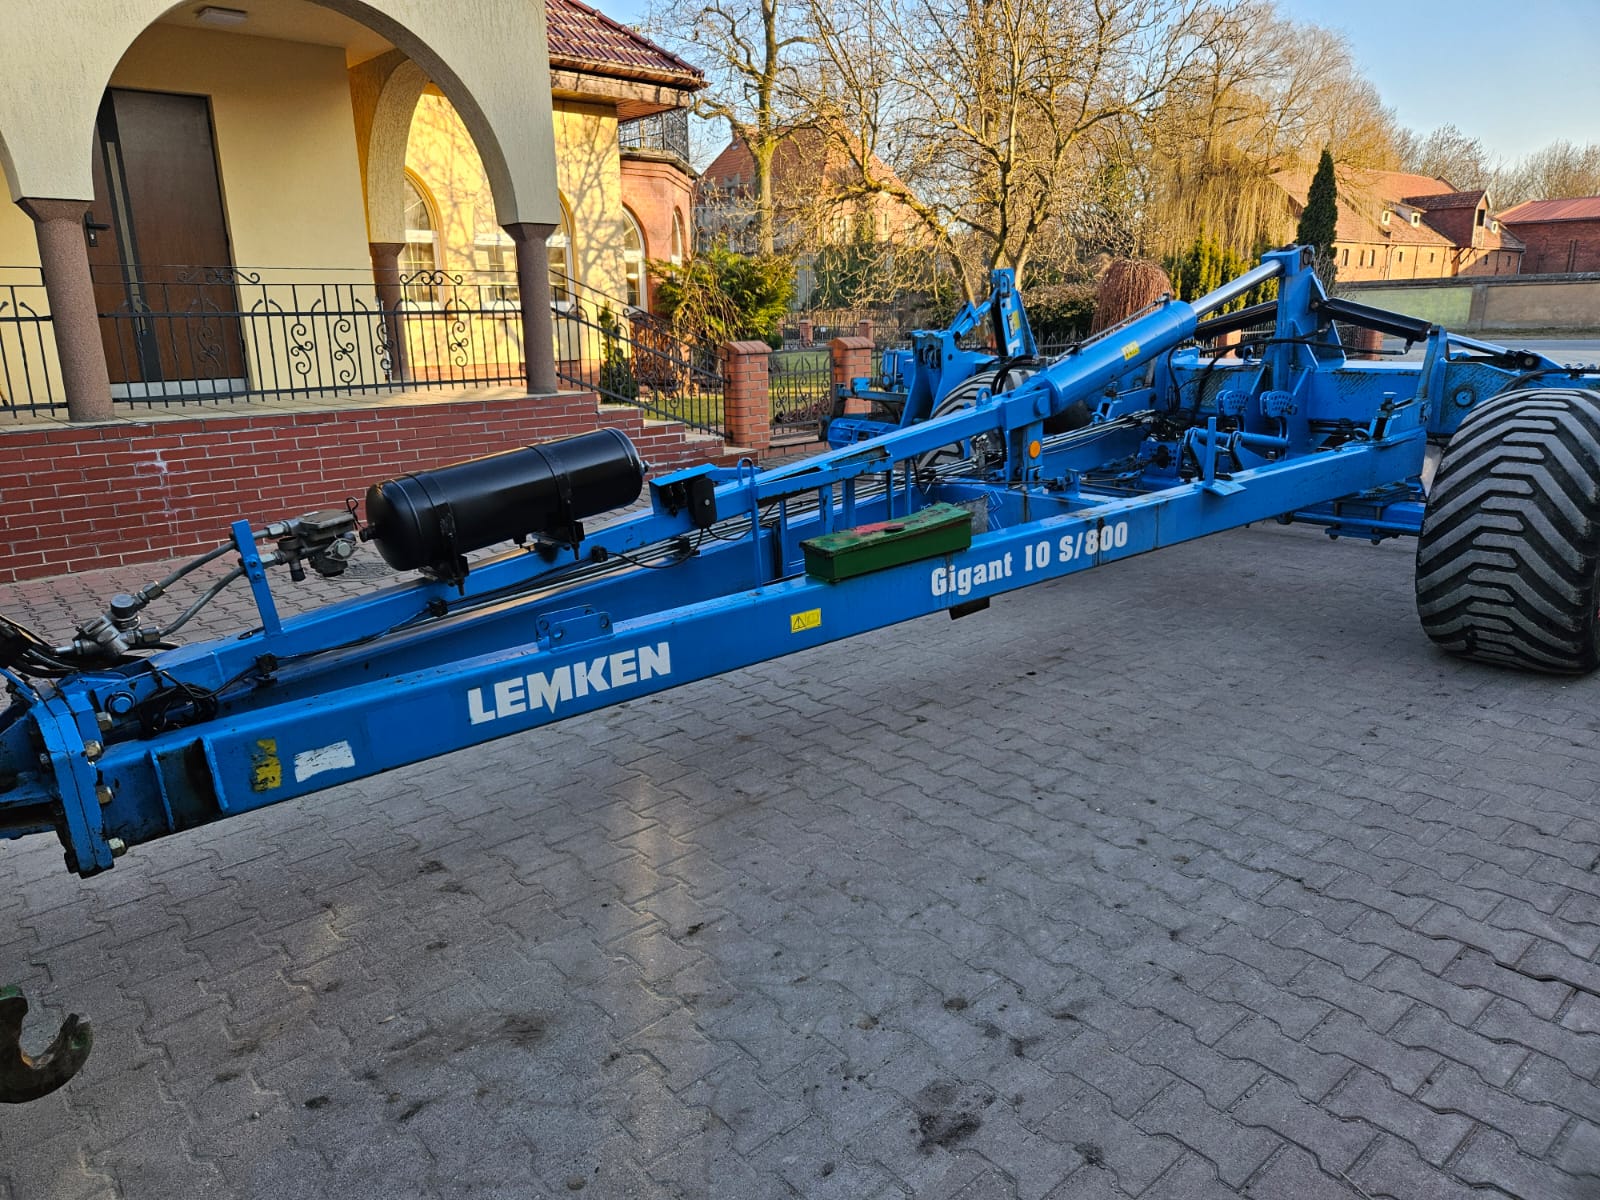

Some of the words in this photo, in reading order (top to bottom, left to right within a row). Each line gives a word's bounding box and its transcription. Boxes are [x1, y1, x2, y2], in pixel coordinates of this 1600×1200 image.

[931, 551, 1013, 597] Gigant
[1024, 541, 1051, 572] 10
[1058, 521, 1128, 563] S/800
[467, 641, 672, 726] LEMKEN
